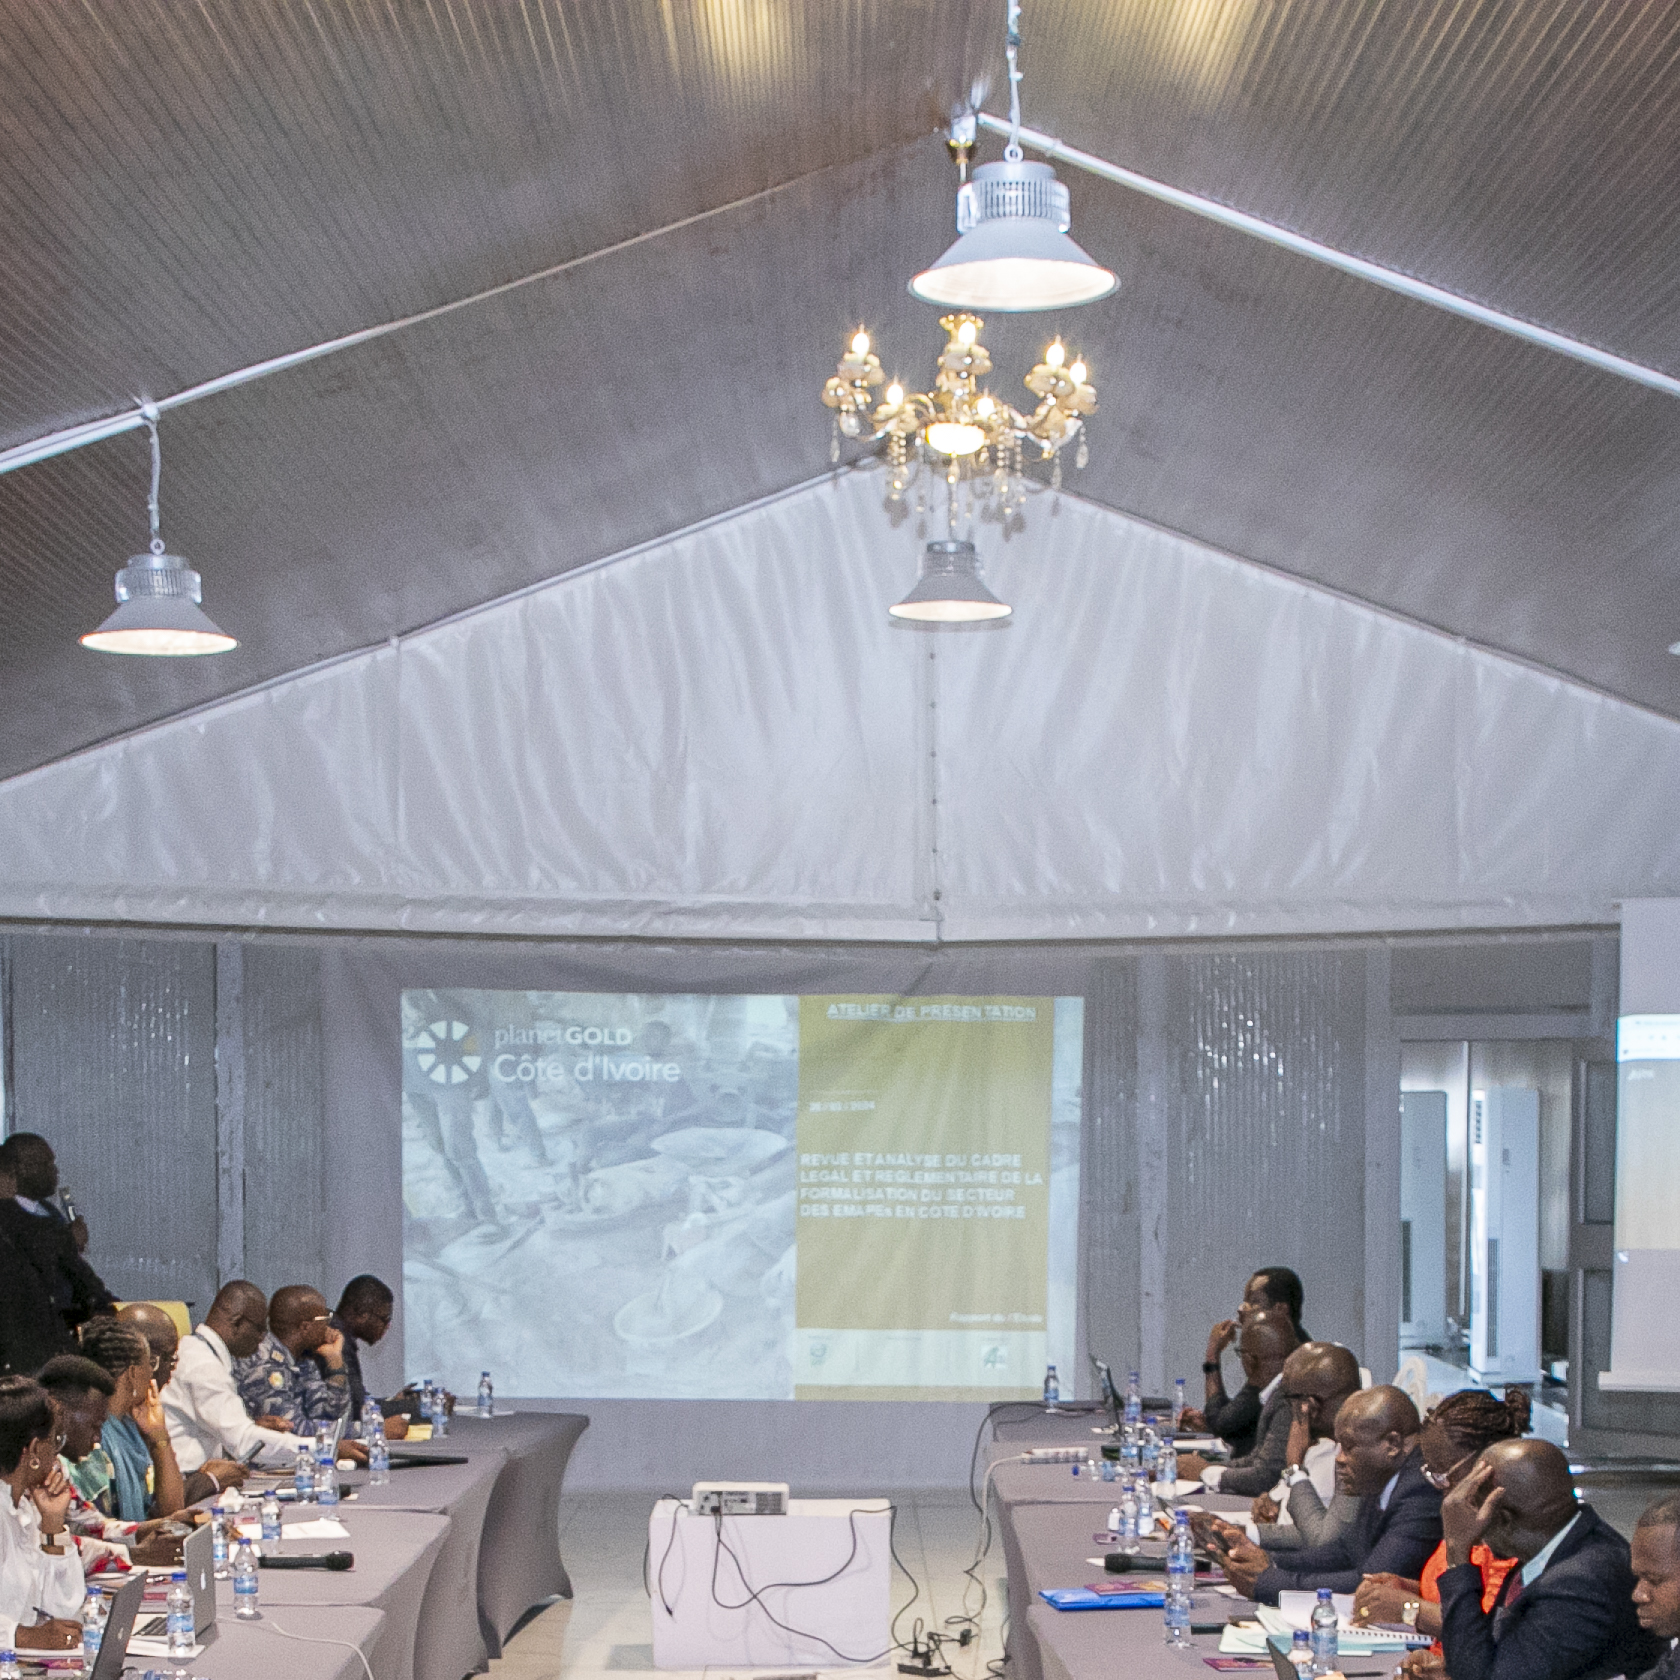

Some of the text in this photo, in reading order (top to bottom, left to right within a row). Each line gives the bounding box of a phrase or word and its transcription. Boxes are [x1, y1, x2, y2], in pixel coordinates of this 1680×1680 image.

[494, 1024, 634, 1050] planetGOLD
[494, 1052, 682, 1083] Côte d'Ivoire
[800, 1152, 1023, 1168] REVUE ET ANALYSE DU CADRE
[852, 1170, 873, 1183] ET
[1001, 1171, 1021, 1184] DE
[1025, 1172, 1043, 1186] LA
[800, 1187, 1016, 1201] FORMALISATION DU SECTEUR
[800, 1203, 830, 1217] DES
[895, 1205, 916, 1218] EN
